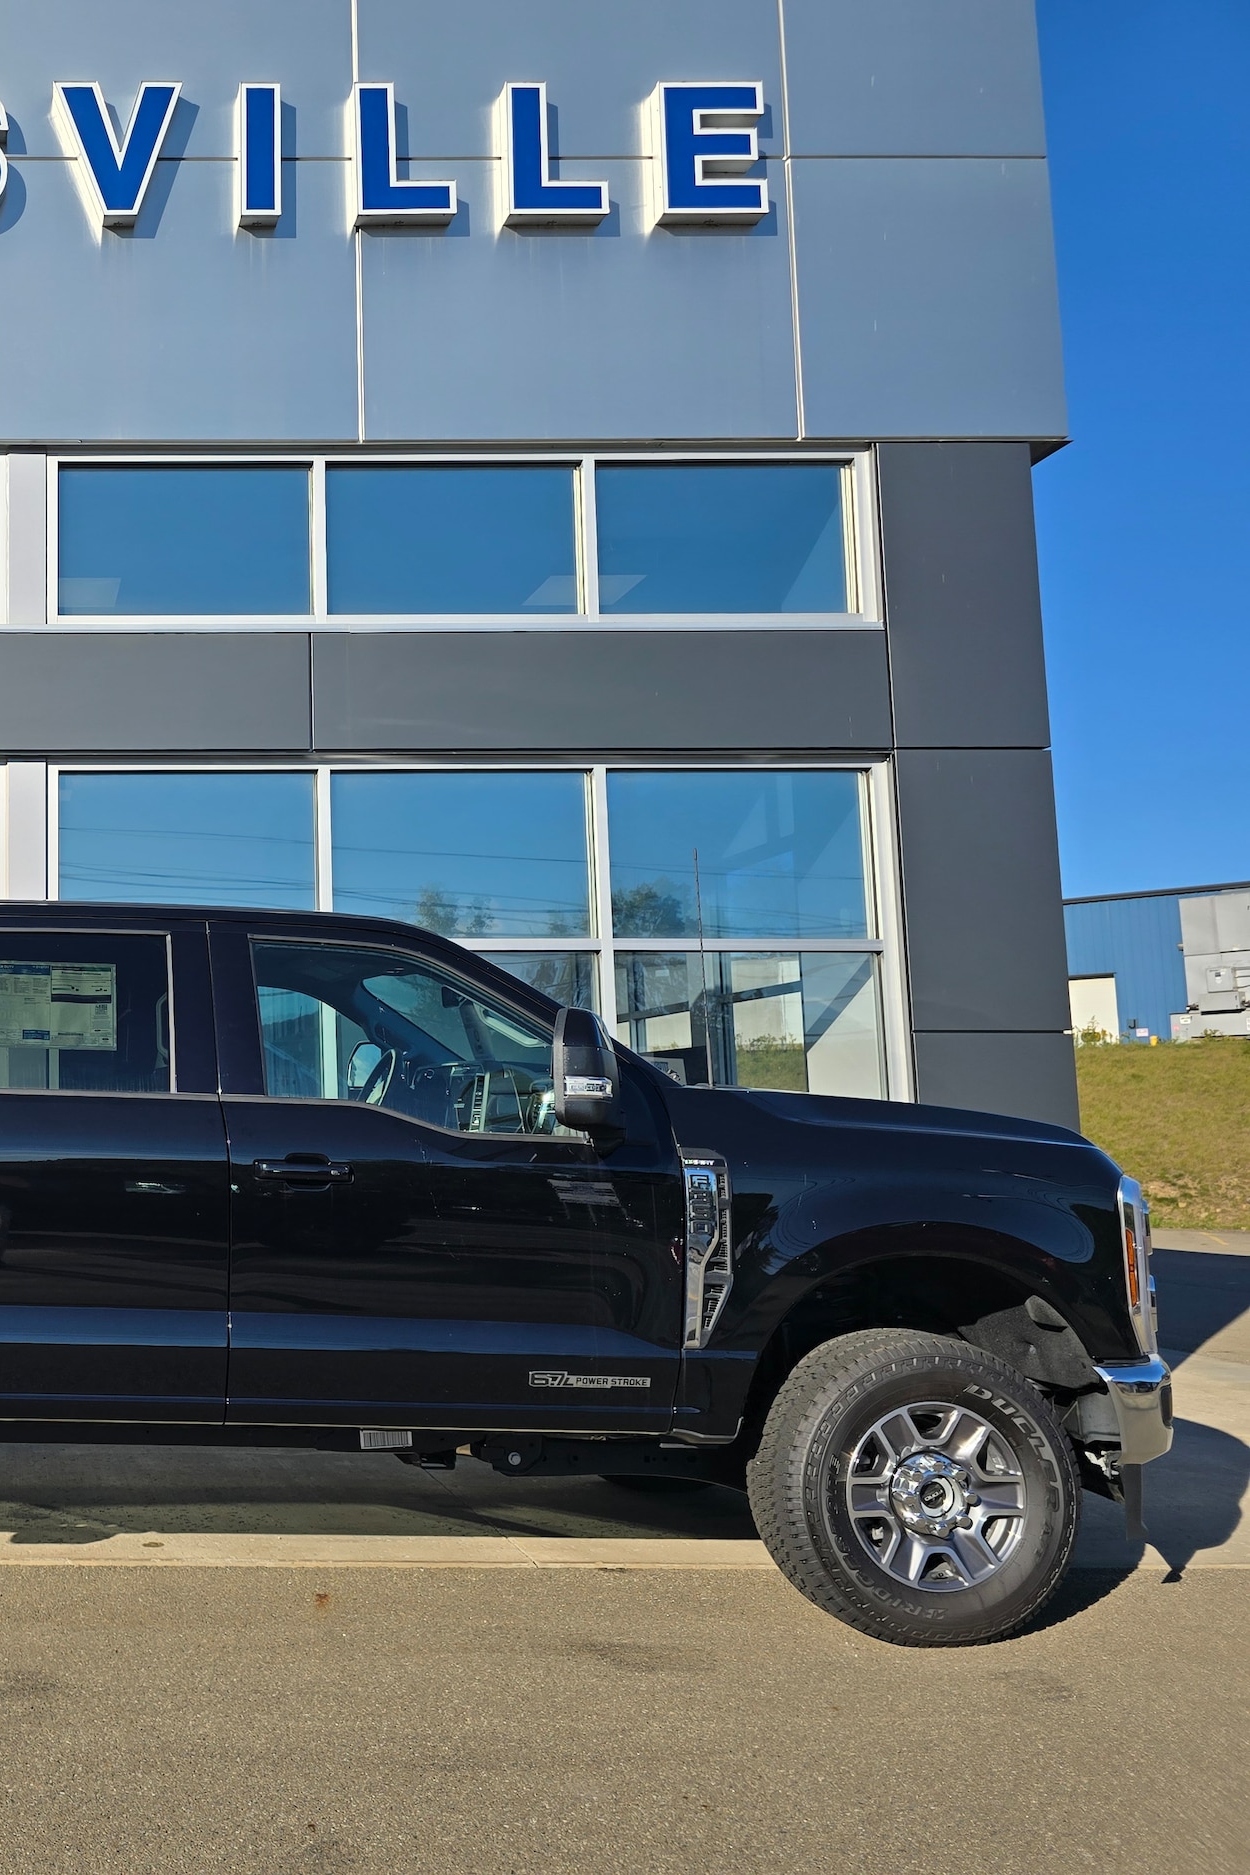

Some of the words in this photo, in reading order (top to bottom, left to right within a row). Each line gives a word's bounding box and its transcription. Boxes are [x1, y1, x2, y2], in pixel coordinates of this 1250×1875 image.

[528, 1370, 574, 1388] 6.7L
[575, 1376, 609, 1386] POWER
[610, 1377, 648, 1387] STROKE
